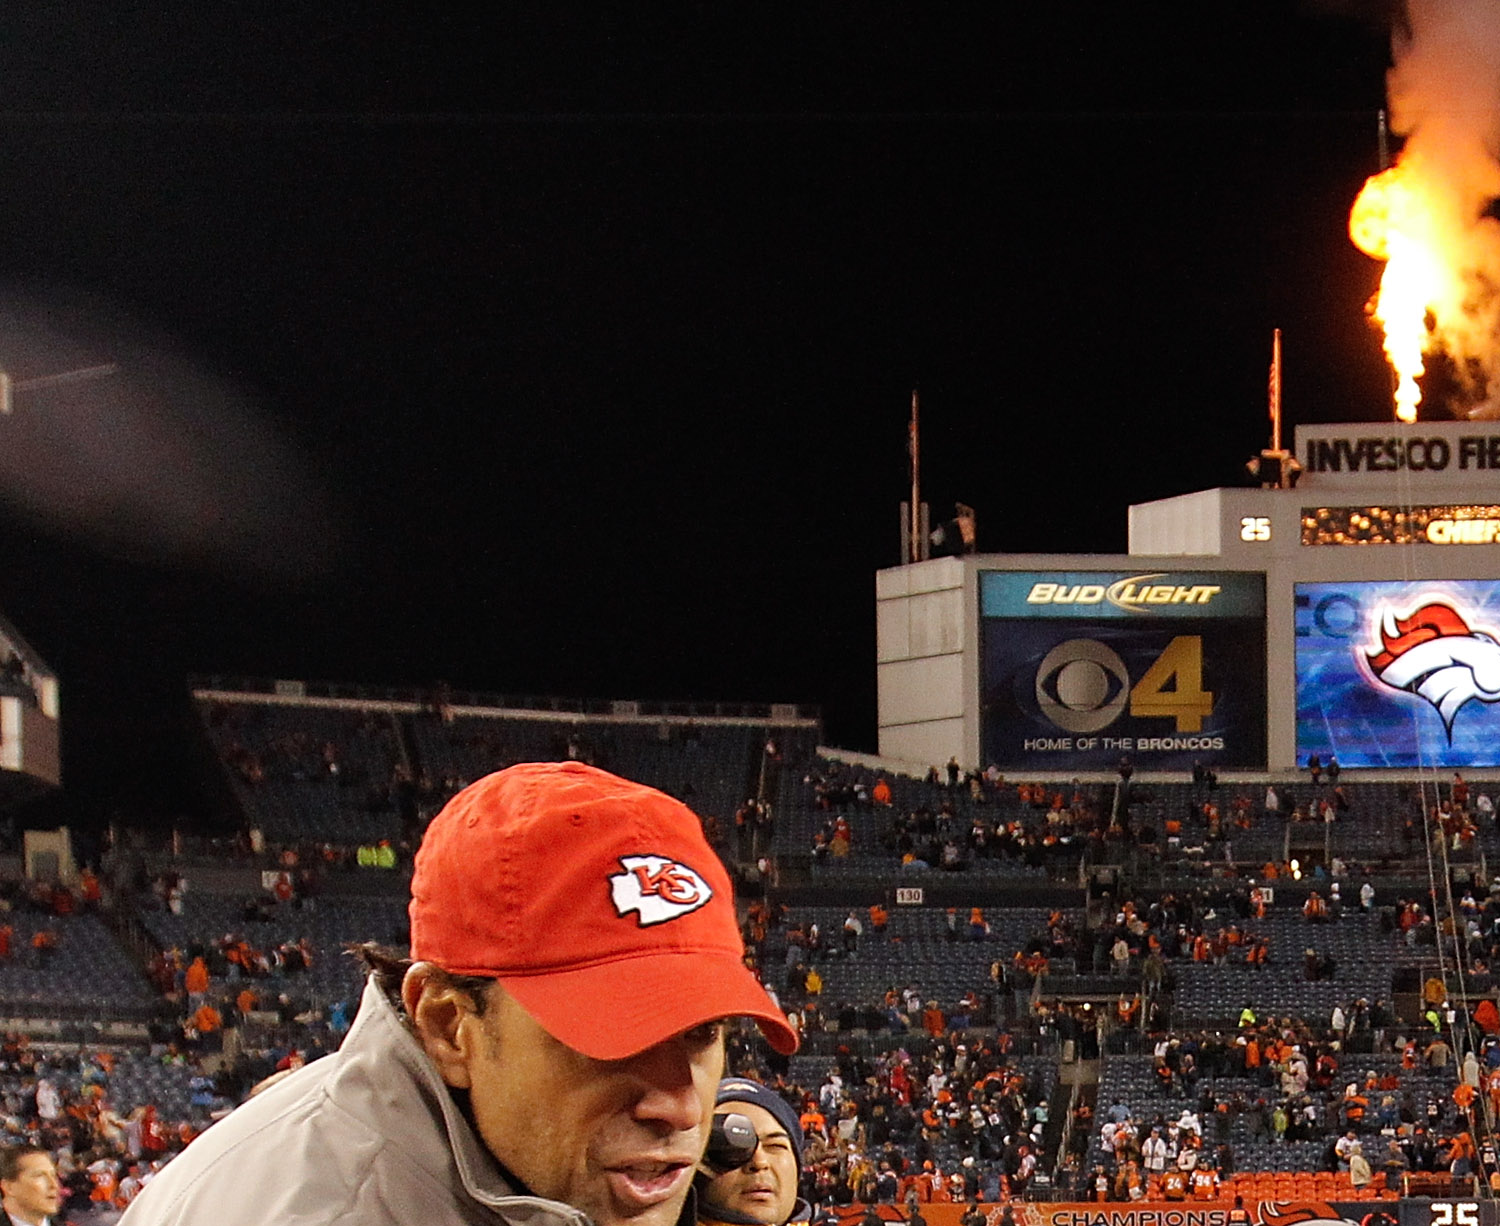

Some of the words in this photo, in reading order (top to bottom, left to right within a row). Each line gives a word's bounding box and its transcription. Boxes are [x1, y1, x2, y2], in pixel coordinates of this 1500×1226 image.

[1306, 436, 1450, 472] INVESCO
[1241, 517, 1271, 541] 25
[1130, 635, 1213, 733] 4
[1024, 738, 1072, 750] HOME
[1076, 738, 1097, 750] OF
[1102, 737, 1133, 750] THE
[1137, 737, 1224, 750] BRONCOS
[632, 863, 701, 905] KC
